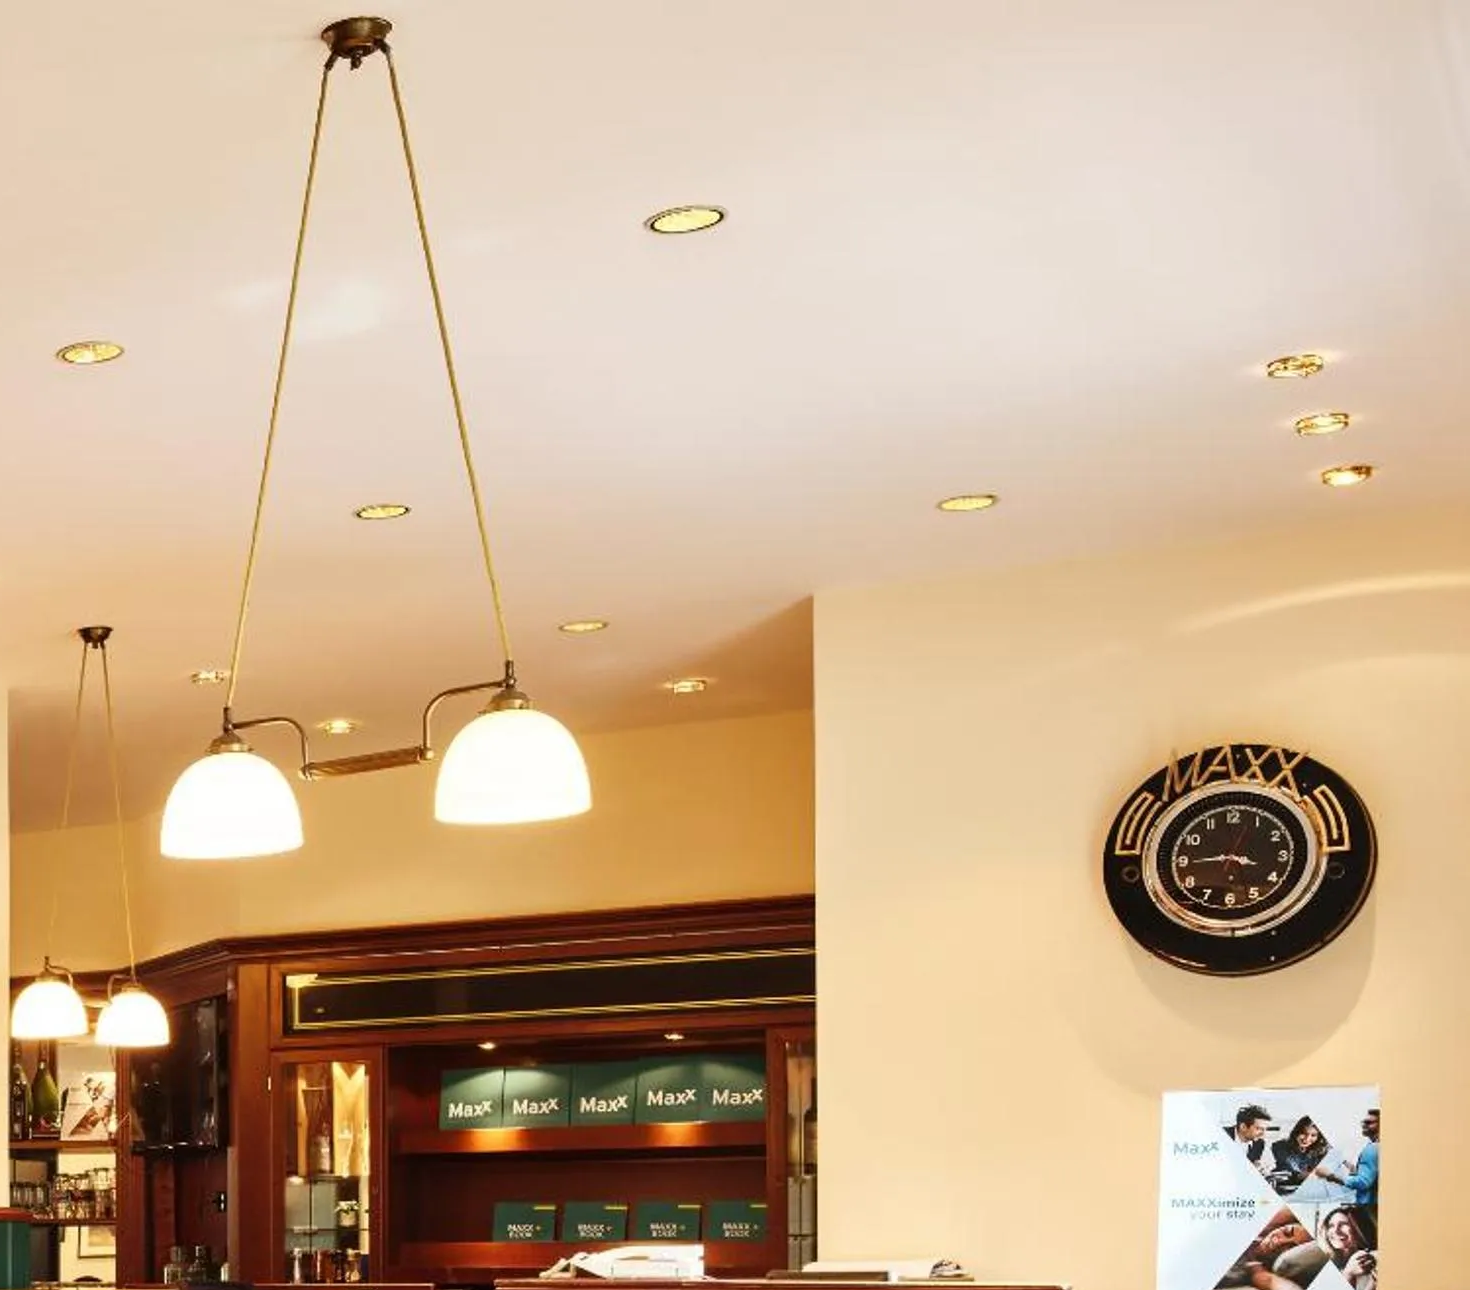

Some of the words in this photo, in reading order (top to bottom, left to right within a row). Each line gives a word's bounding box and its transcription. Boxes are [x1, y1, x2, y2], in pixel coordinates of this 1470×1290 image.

[1161, 744, 1310, 804] MAXX
[1226, 810, 1242, 824] 12
[1255, 815, 1260, 828] 1
[1206, 818, 1215, 830] 11
[1186, 834, 1201, 846] 10
[1270, 830, 1281, 842] 2
[1178, 855, 1189, 867] 9
[1277, 850, 1288, 862] 3
[1185, 875, 1195, 888] 8
[1267, 871, 1278, 883] 4
[1203, 888, 1212, 900] 7
[1224, 893, 1236, 904] 6
[1248, 887, 1259, 899] 5
[580, 1095, 629, 1113] Maxx
[646, 1089, 697, 1106] Maxx
[712, 1089, 763, 1106] Maxx
[448, 1100, 492, 1118] Maxx
[513, 1098, 559, 1115] Maxx
[1173, 1141, 1220, 1156] Maxx
